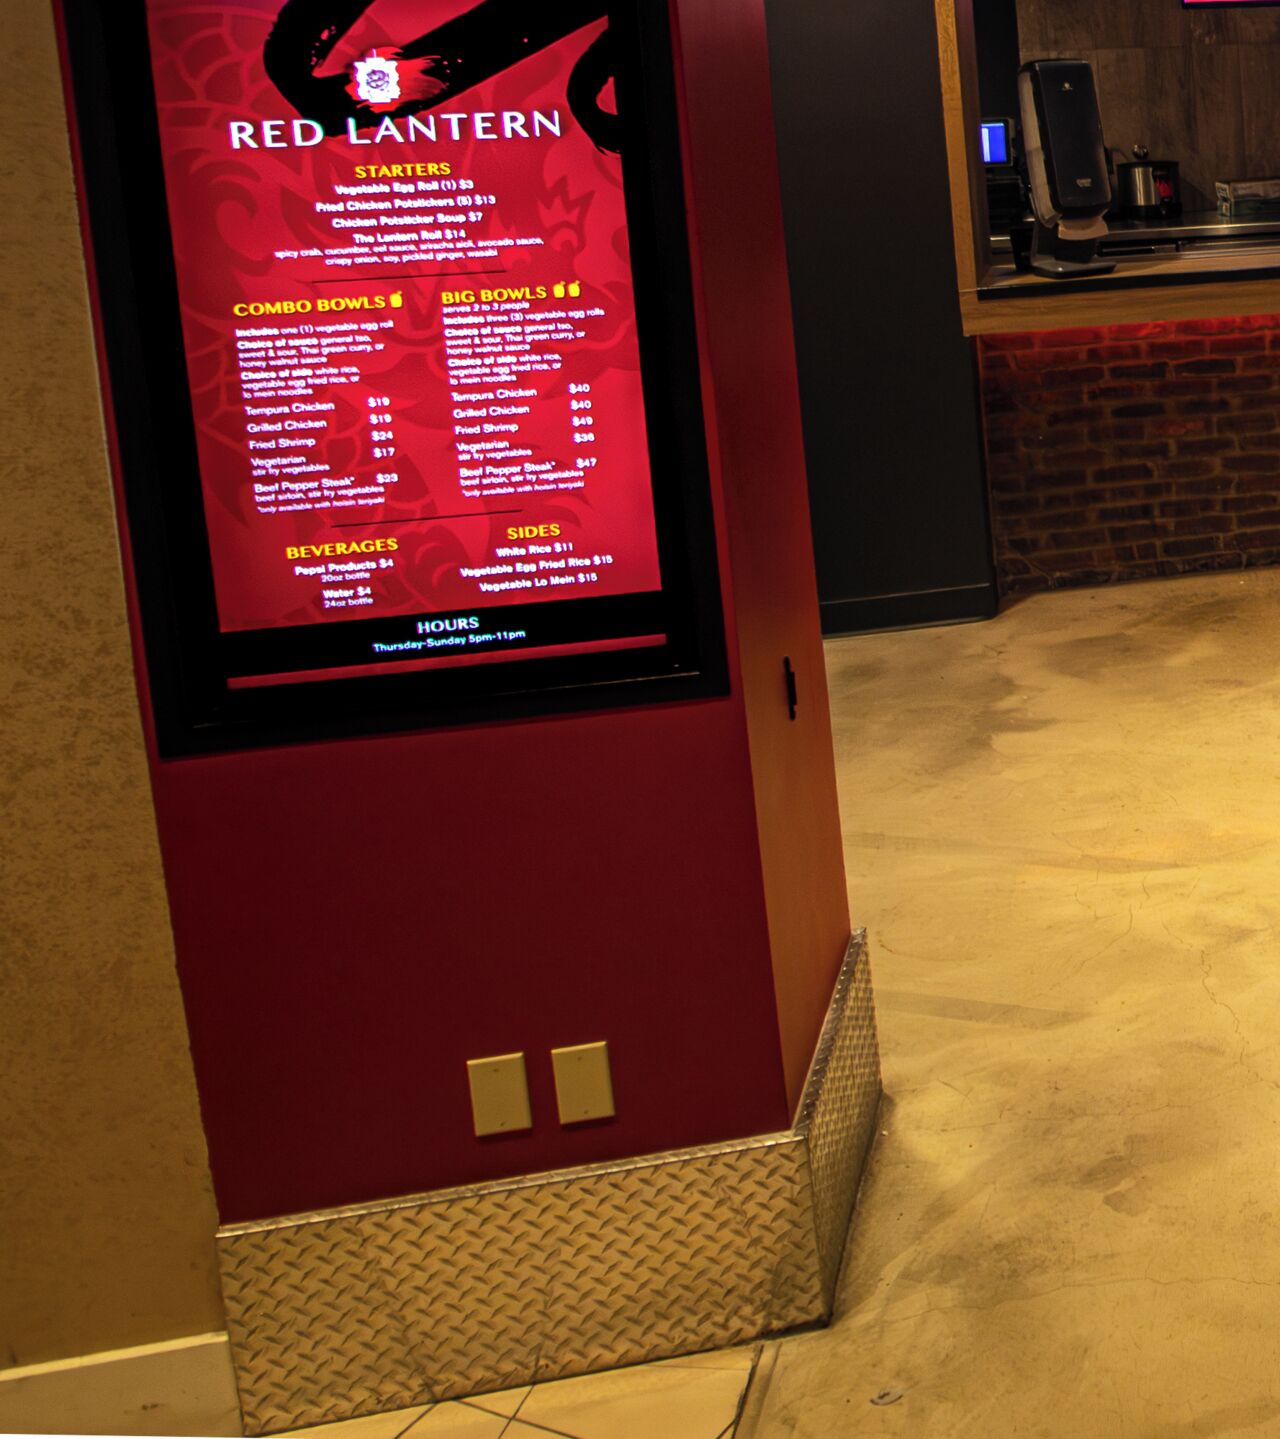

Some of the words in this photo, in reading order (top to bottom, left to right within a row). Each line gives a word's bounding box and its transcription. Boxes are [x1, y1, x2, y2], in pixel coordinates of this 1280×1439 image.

[229, 119, 325, 150] RED
[347, 110, 561, 145] LANTERN
[354, 162, 451, 179] STARTERS
[334, 183, 391, 196] Vegetable
[392, 181, 416, 194] Egg
[417, 180, 440, 192] Roll
[440, 179, 457, 191] (1)
[458, 178, 474, 190] $3
[315, 201, 345, 213] Fried
[345, 200, 393, 211] Chicken
[474, 194, 497, 206] $13
[331, 217, 378, 229] Chicken
[379, 214, 435, 226] Potsticker
[436, 212, 467, 224] Soup
[468, 210, 483, 223] $7
[352, 233, 376, 244] The
[376, 232, 419, 243] Lantern
[420, 229, 443, 241] Roll
[444, 228, 467, 240] $14
[441, 290, 476, 305] BIG
[480, 286, 547, 302] BOWLS
[233, 299, 312, 317] COMBO
[316, 295, 386, 312] BOWLS
[299, 324, 314, 335] (1)
[314, 322, 359, 334] vegetable
[359, 322, 379, 331] egg
[379, 319, 394, 329] roll
[236, 340, 274, 350] Choice
[274, 338, 287, 348] of
[238, 350, 266, 359] sweet
[320, 345, 348, 356] green
[374, 343, 385, 351] or
[240, 370, 278, 381] Choice
[278, 368, 291, 378] of
[314, 367, 340, 375] white
[450, 391, 495, 402] Tempura
[496, 388, 538, 399] Chicken
[569, 382, 591, 395] $40
[244, 405, 291, 416] Tempura
[291, 402, 336, 413] Chicken
[453, 407, 488, 419] Grilled
[488, 405, 530, 417] Chicken
[570, 399, 592, 411] $40
[246, 421, 283, 433] Grilled
[283, 419, 328, 431] Chicken
[454, 424, 481, 435] Fried
[482, 423, 519, 434] Shrimp
[249, 439, 277, 450] Fried
[278, 437, 316, 448] Shrimp
[371, 430, 394, 442] $24
[456, 440, 510, 453] Vegetarian
[250, 455, 307, 469] Vegetarian
[459, 466, 484, 478] Beef
[485, 465, 522, 477] Pepper
[253, 482, 280, 494] Beef
[281, 481, 320, 492] Pepper
[376, 472, 399, 484] $23
[507, 523, 561, 540] SIDES
[286, 537, 399, 560] BEVERAGES
[495, 546, 527, 558] White
[528, 544, 552, 555] Rice
[553, 541, 573, 553] $11
[294, 564, 326, 576] Pepsi
[327, 560, 378, 573] Products
[379, 558, 394, 569] $4
[459, 564, 514, 578] Vegetable
[515, 562, 537, 573] Egg
[538, 558, 566, 570] Fried
[567, 557, 592, 568] Rice
[321, 573, 344, 583] 20oz
[344, 571, 371, 581] bottle
[479, 578, 533, 592] Vegetable
[534, 577, 548, 587] Lo
[549, 575, 576, 585] Mein
[322, 588, 355, 599] Water
[356, 585, 372, 597] $4
[324, 599, 346, 609] 24oz
[347, 596, 374, 606] bottle
[417, 616, 480, 634] HOURS
[373, 636, 467, 652] Thursday-Sunday
[468, 630, 526, 644] 5pm-11pm
